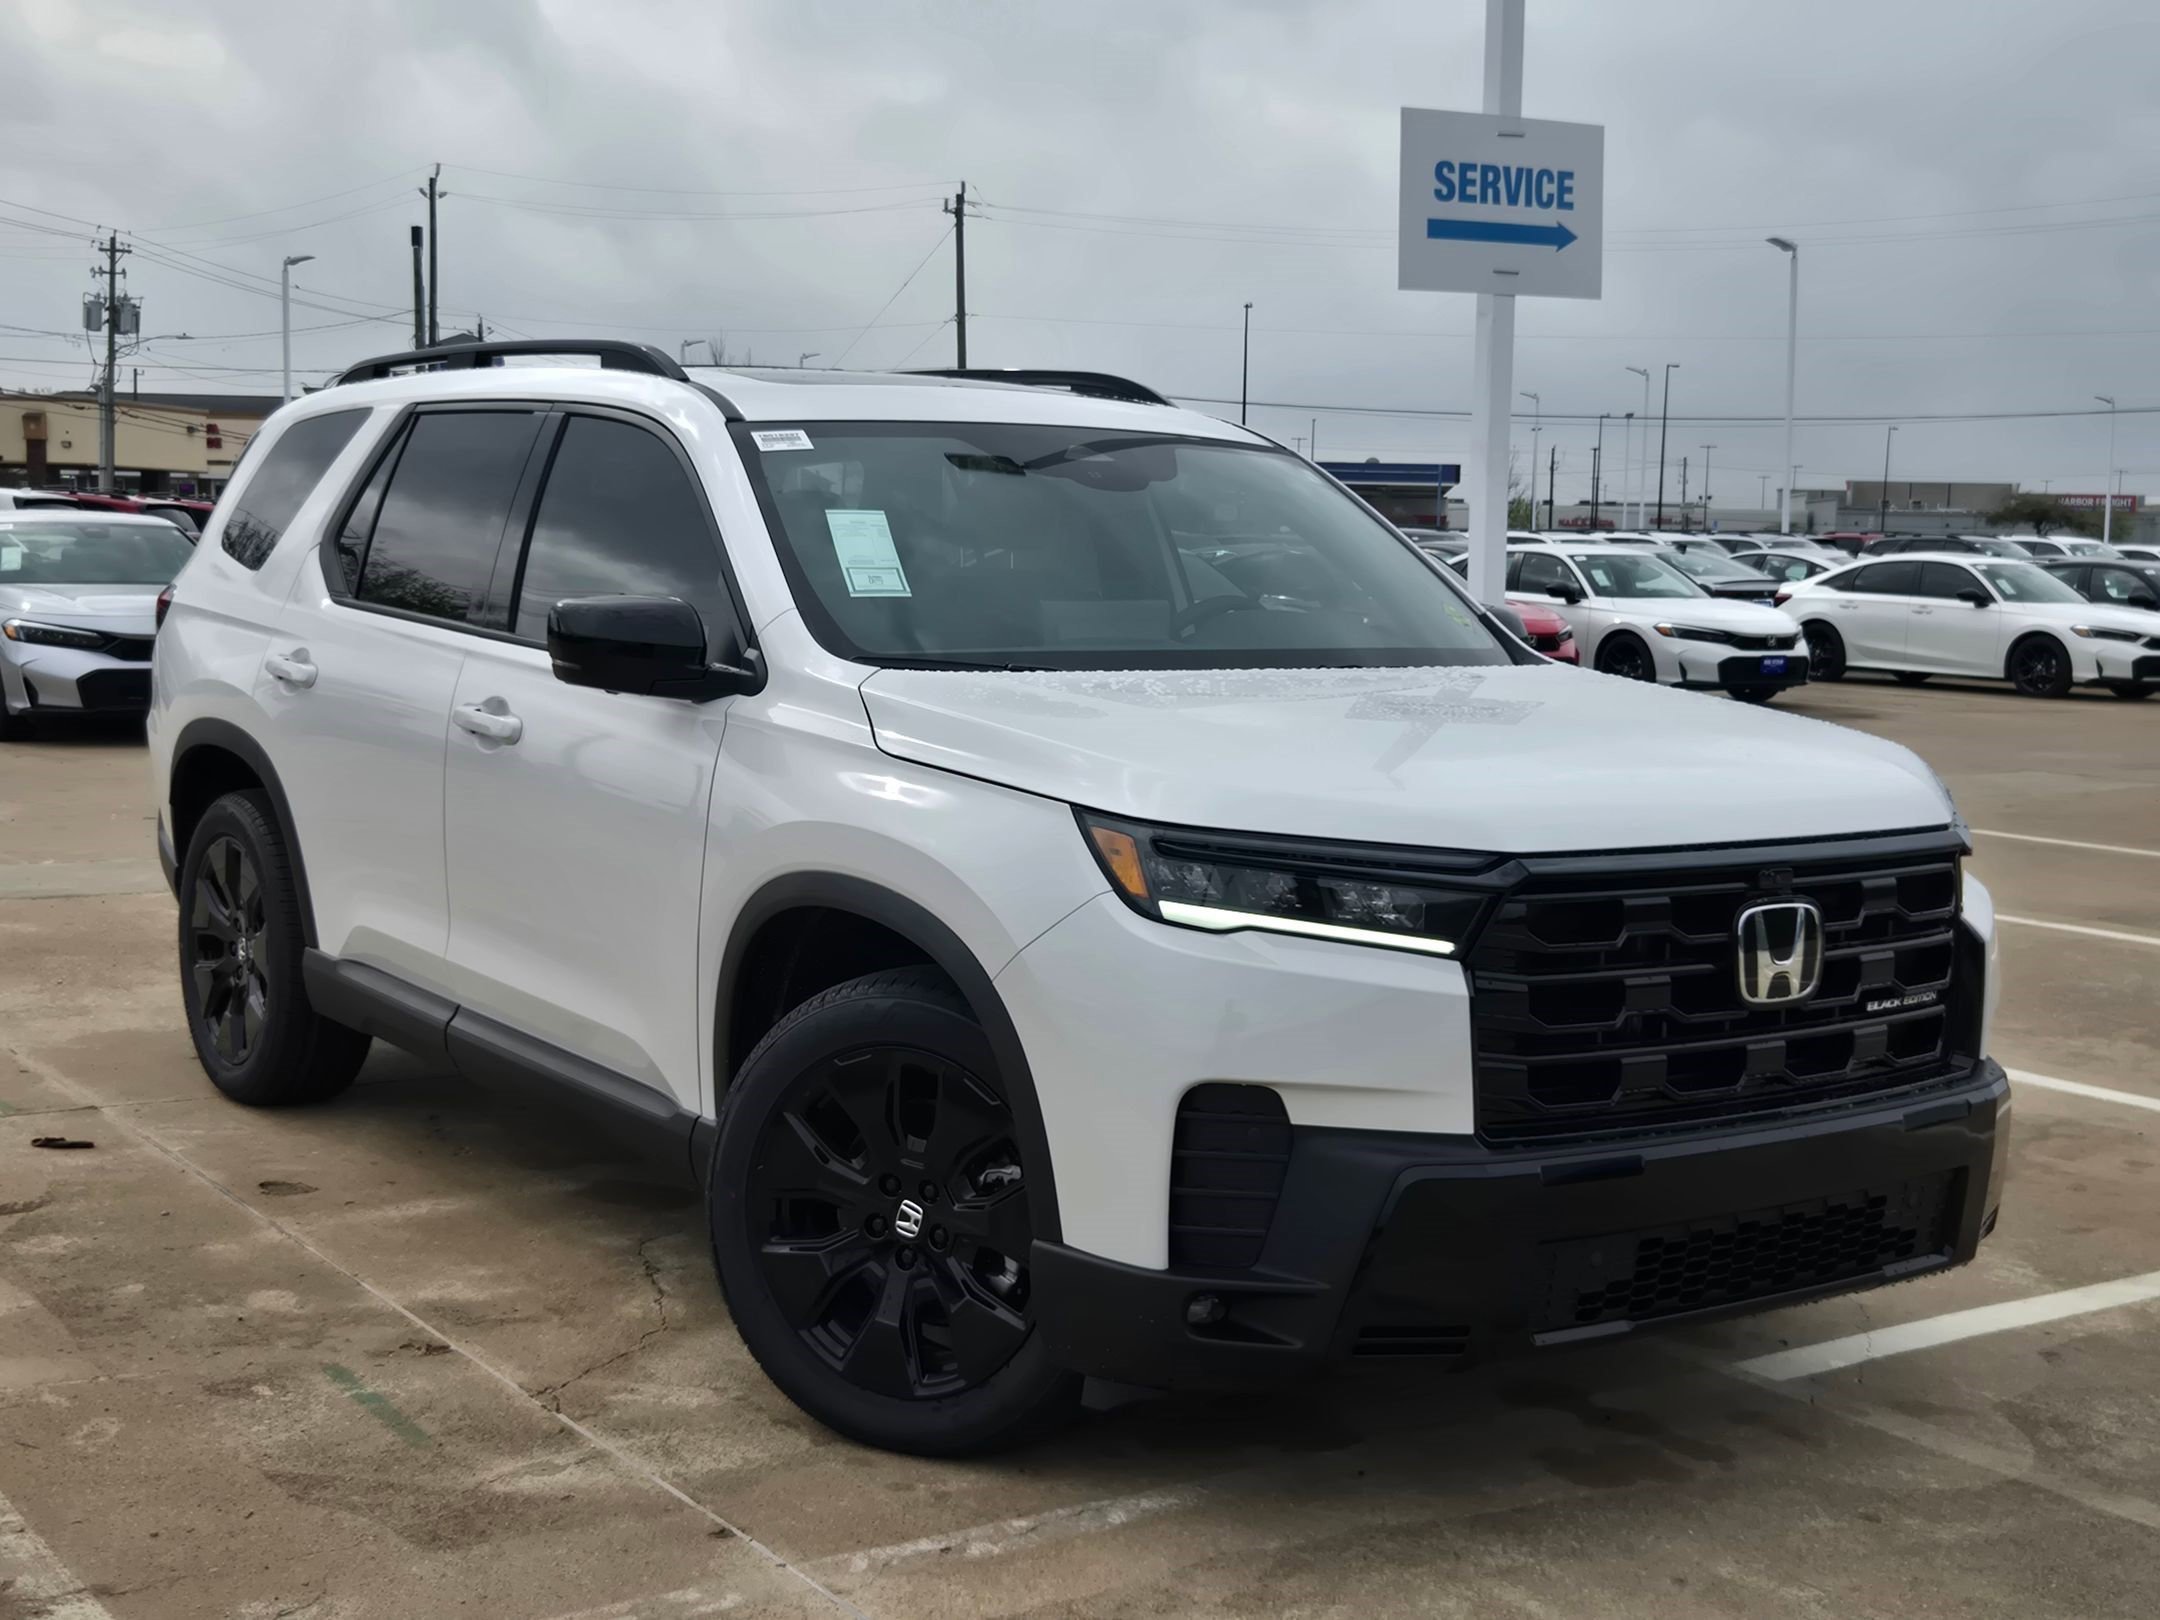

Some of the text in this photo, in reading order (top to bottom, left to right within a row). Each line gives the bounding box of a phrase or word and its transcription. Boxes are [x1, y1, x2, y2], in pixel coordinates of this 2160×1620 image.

[1433, 160, 1575, 211] SERVICE
[2095, 497, 2132, 507] FRIGHT
[1866, 991, 1937, 1011] BLACK EDITION
